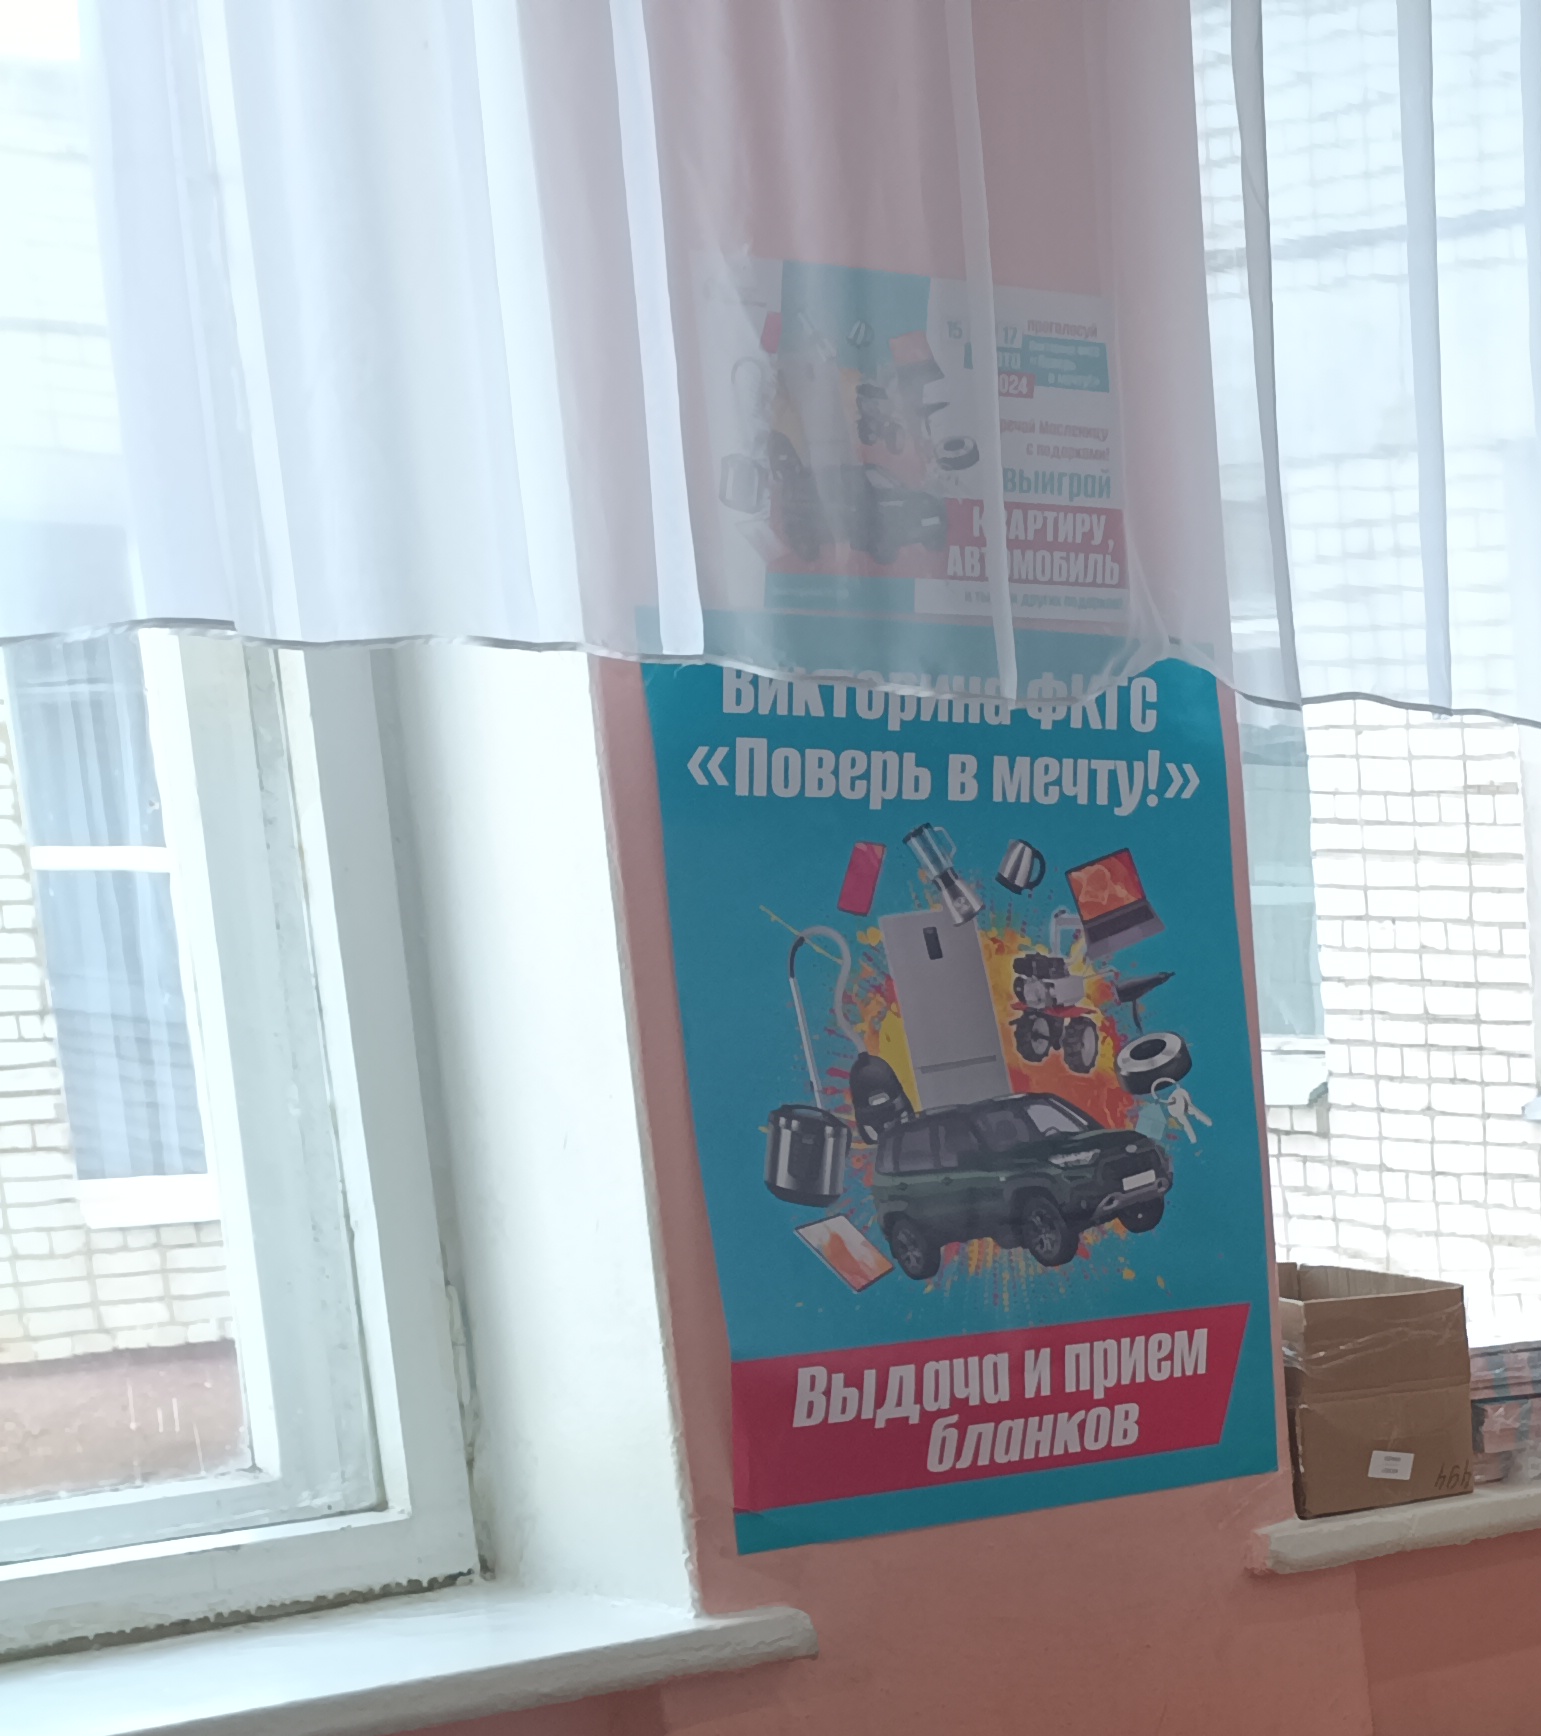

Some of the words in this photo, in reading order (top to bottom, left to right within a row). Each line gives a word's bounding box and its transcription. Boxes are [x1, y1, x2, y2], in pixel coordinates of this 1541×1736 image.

[1000, 373, 1029, 395] 024
[972, 505, 1115, 553] КАРТИРУ,
[947, 544, 1120, 586] АВМОБИЛЬ
[686, 737, 932, 810] «Поверь
[948, 753, 979, 802] в
[993, 749, 1201, 817] мечту!»
[792, 1352, 1009, 1429] Выдача
[1024, 1347, 1052, 1399] и
[1064, 1328, 1209, 1401] прием
[926, 1402, 1140, 1474] бланков
